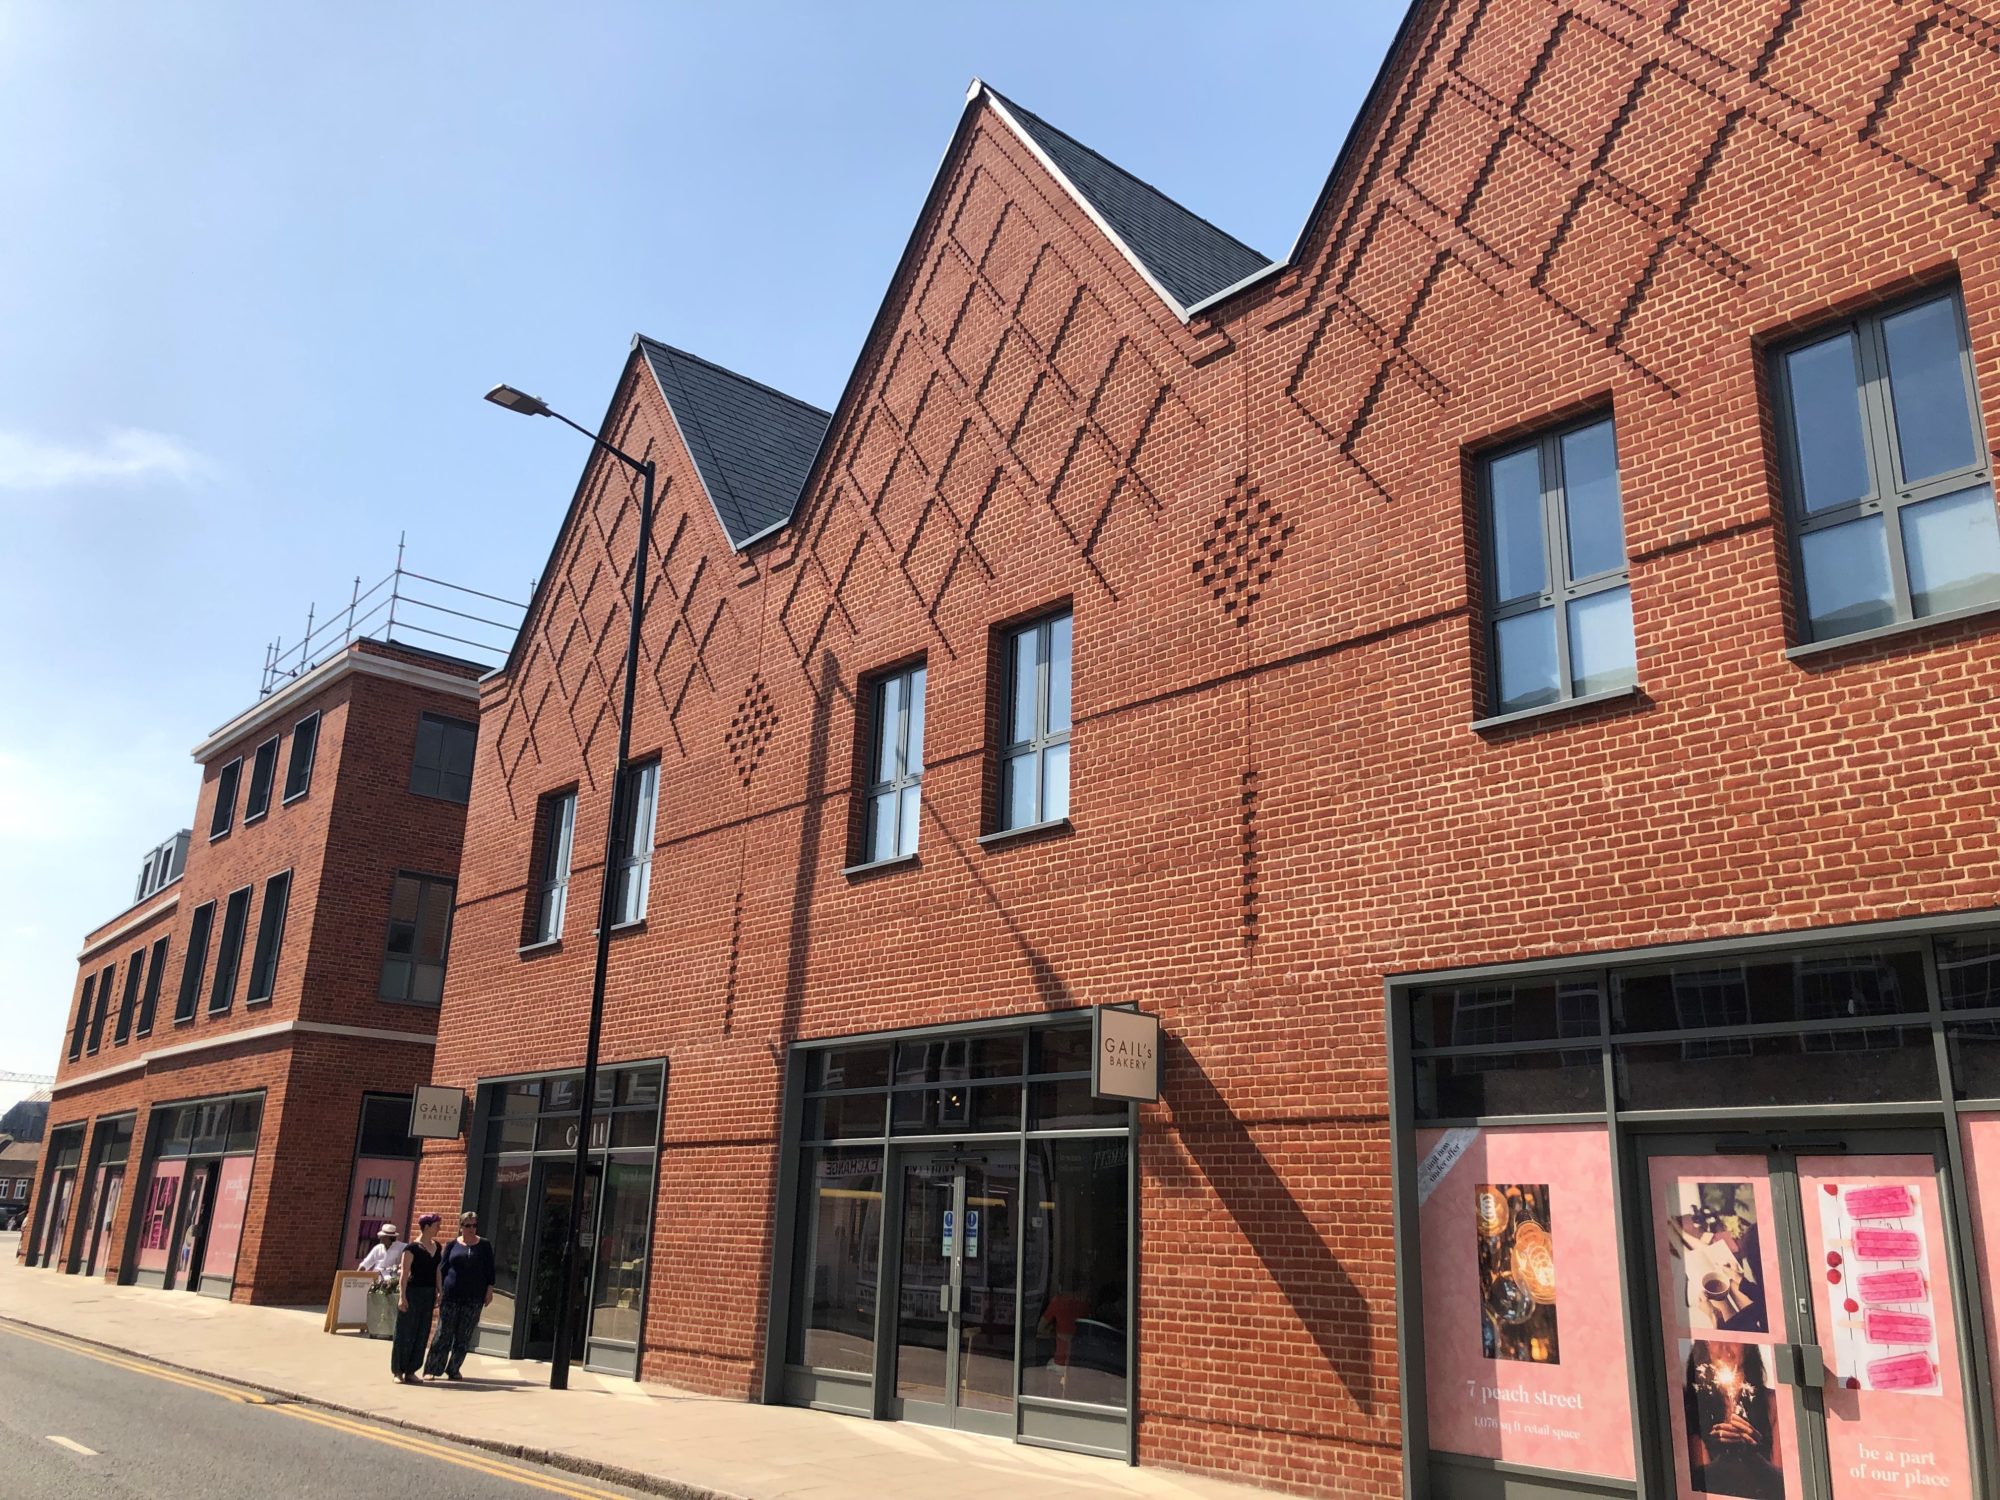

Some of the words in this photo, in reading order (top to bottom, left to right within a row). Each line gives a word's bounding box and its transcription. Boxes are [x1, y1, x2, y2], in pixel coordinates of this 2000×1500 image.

[1104, 1037, 1152, 1059] GAIL's
[1109, 1055, 1147, 1070] BAKERY
[1446, 1143, 1461, 1162] offer
[1466, 1380, 1476, 1397] 7
[1481, 1384, 1530, 1405] peach
[1533, 1390, 1584, 1409] street
[1499, 1422, 1512, 1434] sq
[1523, 1423, 1550, 1436] retail
[1552, 1428, 1581, 1440] space
[1859, 1443, 1880, 1460] be
[1885, 1450, 1894, 1462] a
[1900, 1451, 1936, 1468] part
[1850, 1463, 1867, 1479] of
[1871, 1469, 1900, 1482] our
[1904, 1468, 1951, 1488] place
